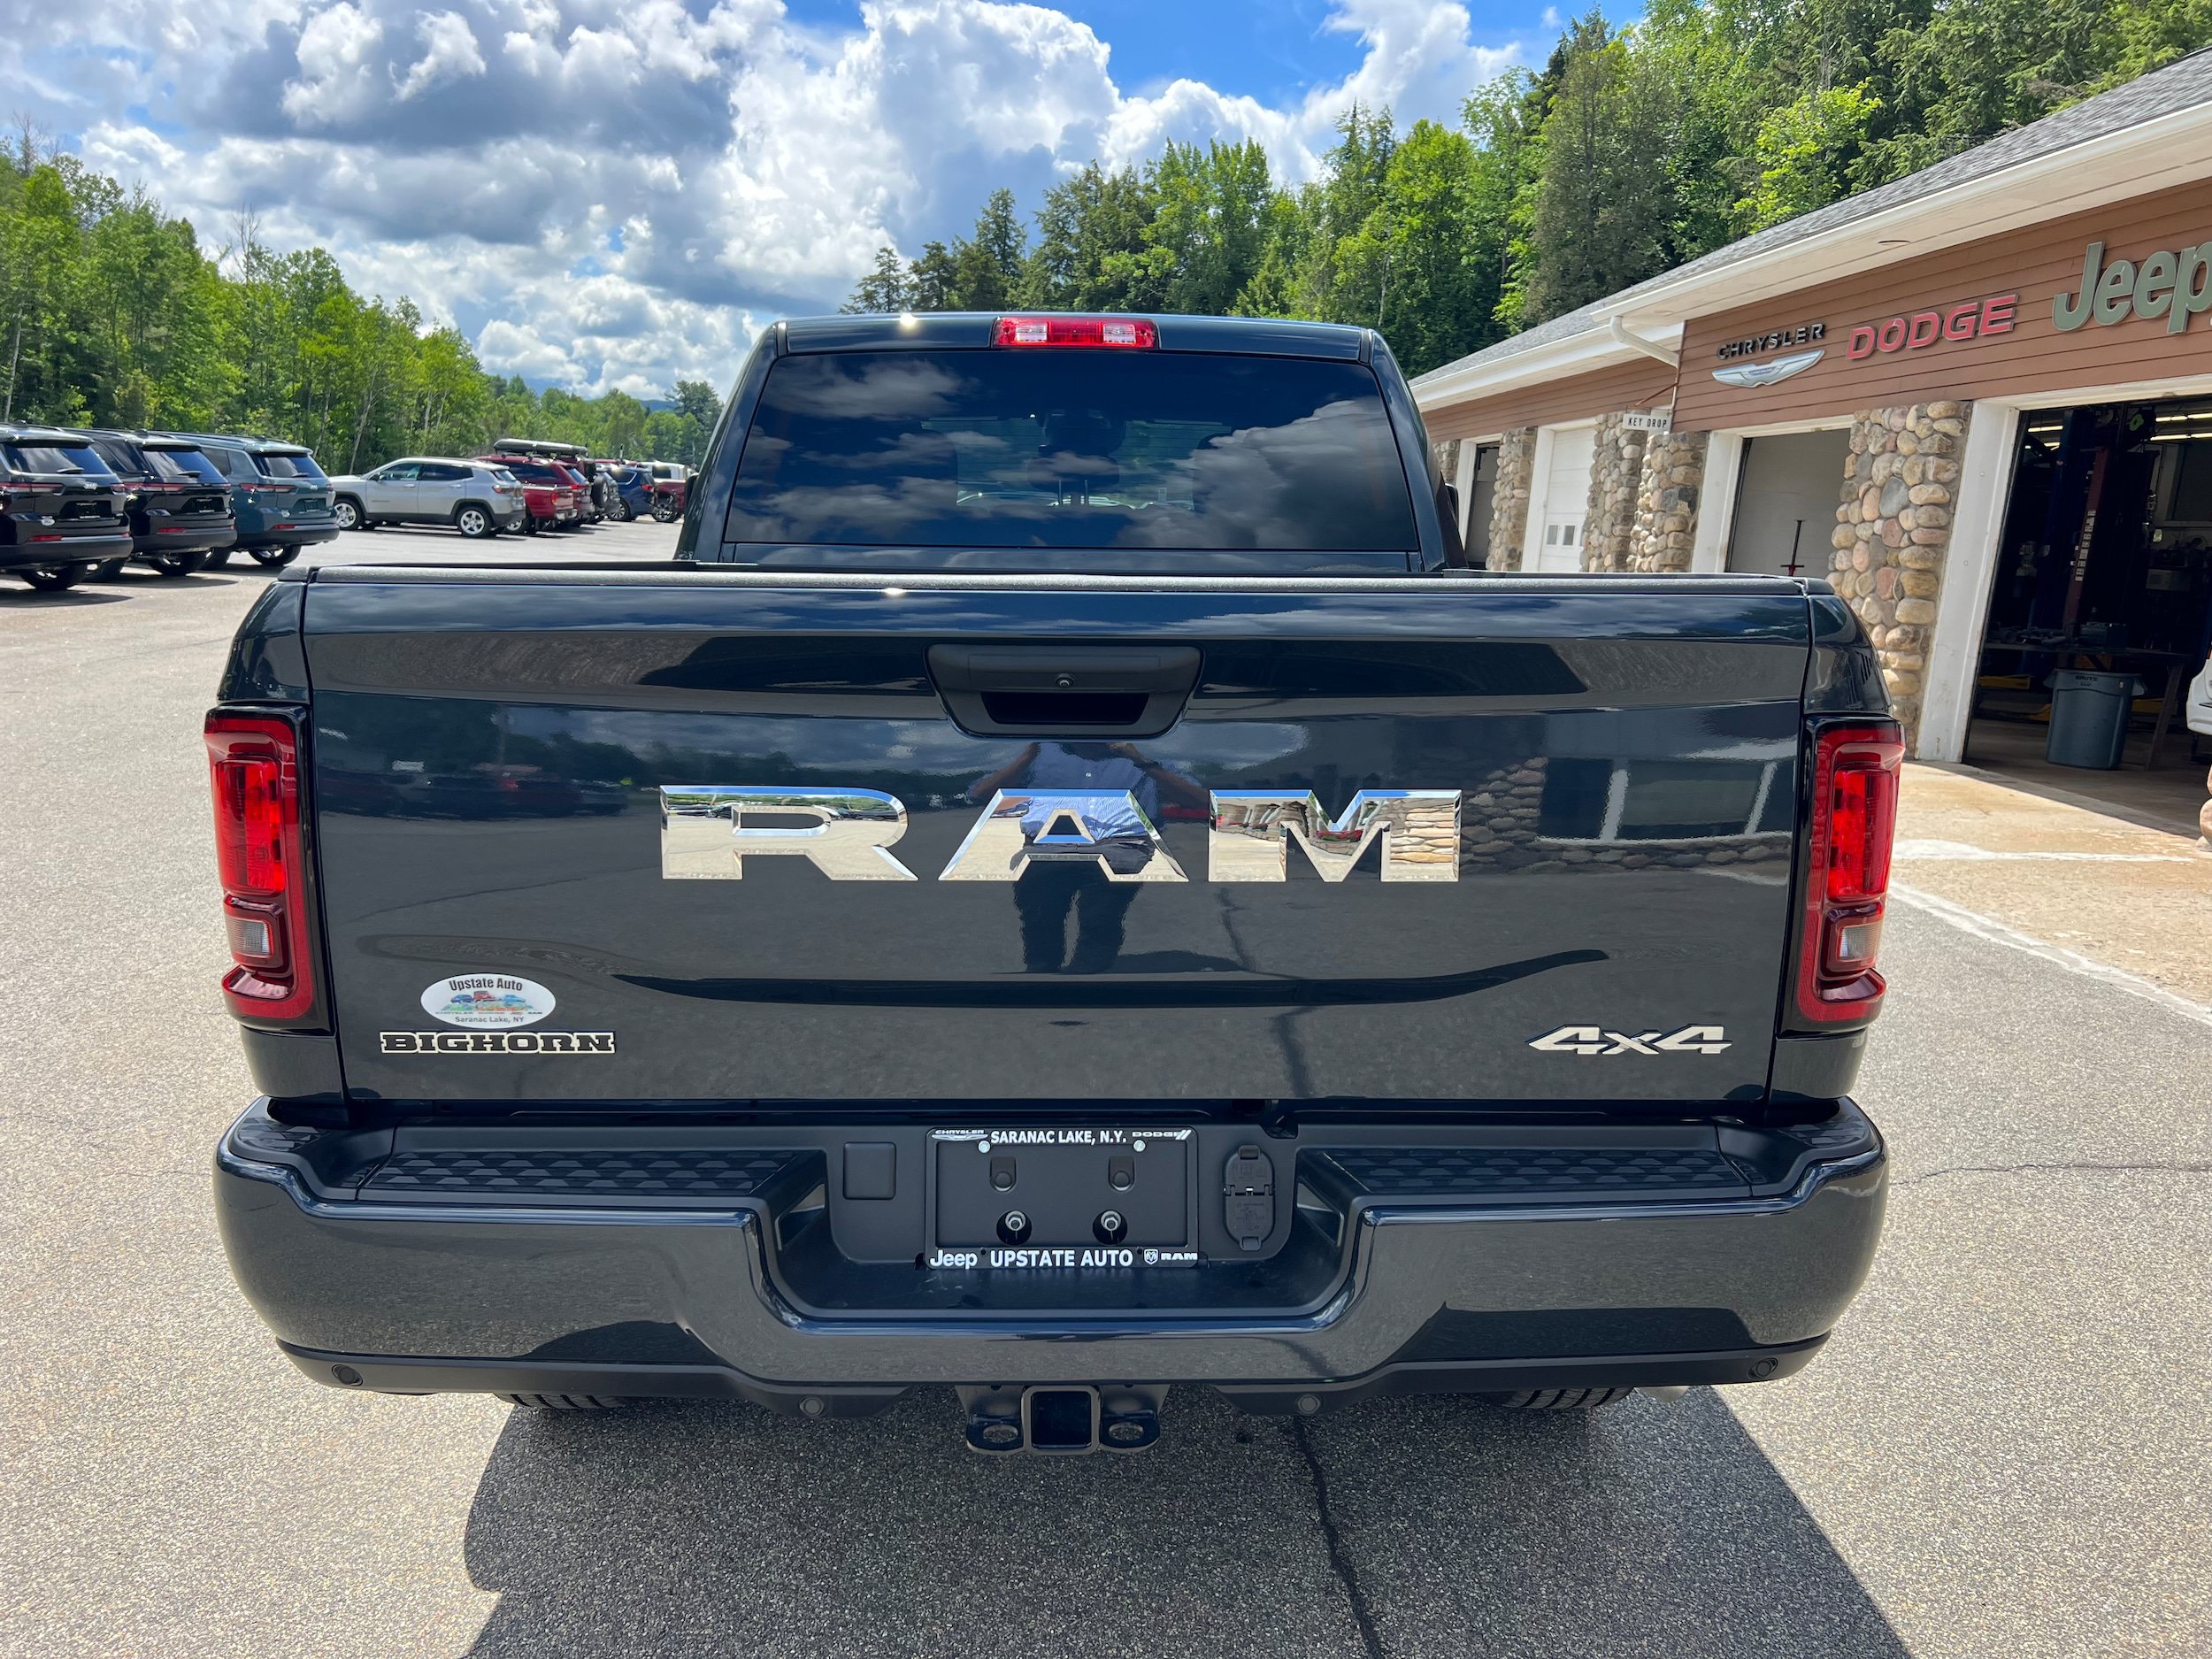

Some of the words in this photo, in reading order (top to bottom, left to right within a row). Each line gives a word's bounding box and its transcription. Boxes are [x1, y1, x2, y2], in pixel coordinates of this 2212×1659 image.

[2052, 241, 2212, 334] Jeep
[1846, 293, 2021, 361] DODGE
[1717, 323, 1826, 360] CHRYSLER
[1628, 417, 1643, 426] KEY
[1647, 419, 1668, 428] DROP
[660, 785, 1463, 882] RAM
[449, 978, 495, 992] Upstate
[496, 978, 524, 991] Auto
[380, 1032, 616, 1054] BIGHORN
[1528, 1025, 1732, 1055] 4x4
[990, 1131, 1057, 1143] SARANAC
[1058, 1131, 1096, 1145] LAKE,
[1099, 1131, 1128, 1143] N.Y.
[929, 1249, 979, 1270] Jeep
[990, 1249, 1076, 1267] UPSTATE
[1079, 1249, 1133, 1267] AUTO
[1160, 1252, 1198, 1261] RAM
